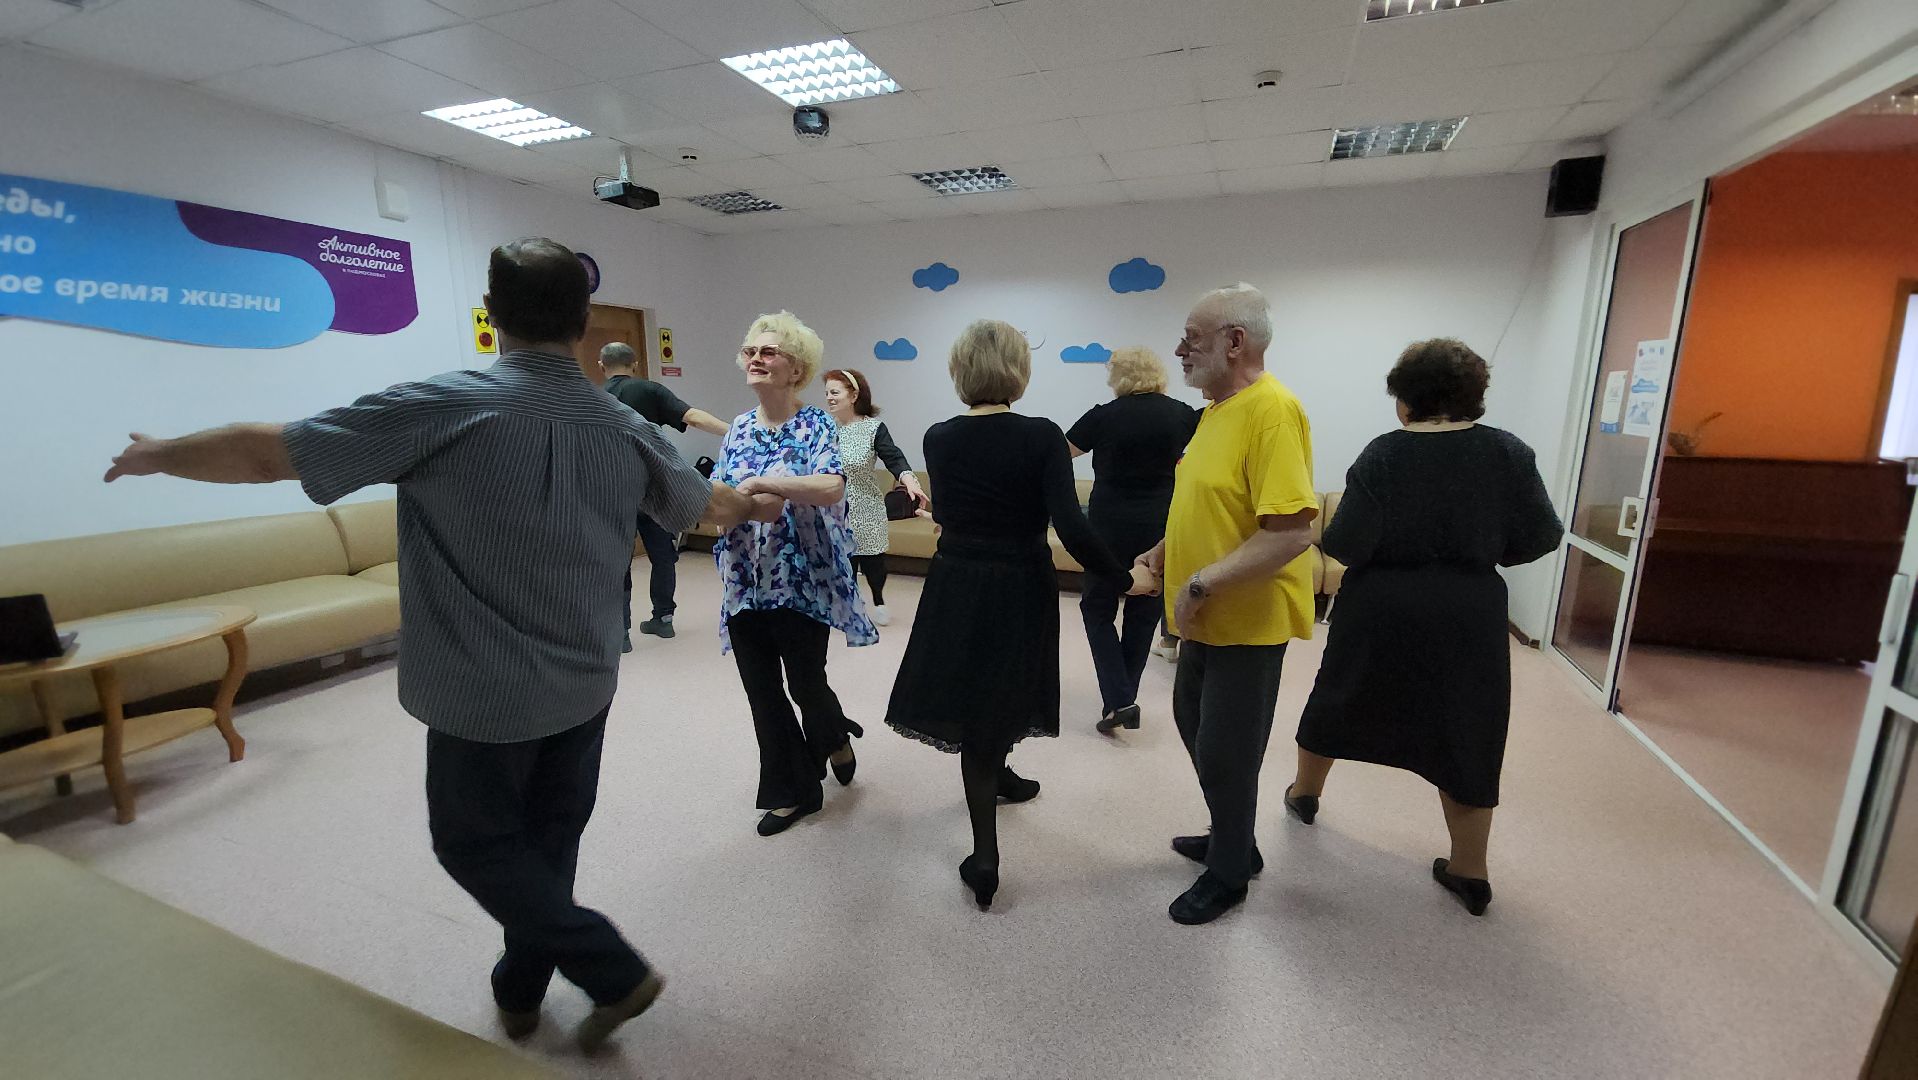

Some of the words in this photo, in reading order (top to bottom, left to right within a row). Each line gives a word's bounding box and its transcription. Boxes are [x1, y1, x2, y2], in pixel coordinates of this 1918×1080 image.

[0, 187, 76, 224] ды,
[318, 235, 401, 260] Активное
[319, 247, 405, 273] долголетие
[55, 278, 169, 304] время
[179, 288, 281, 312] жизни
